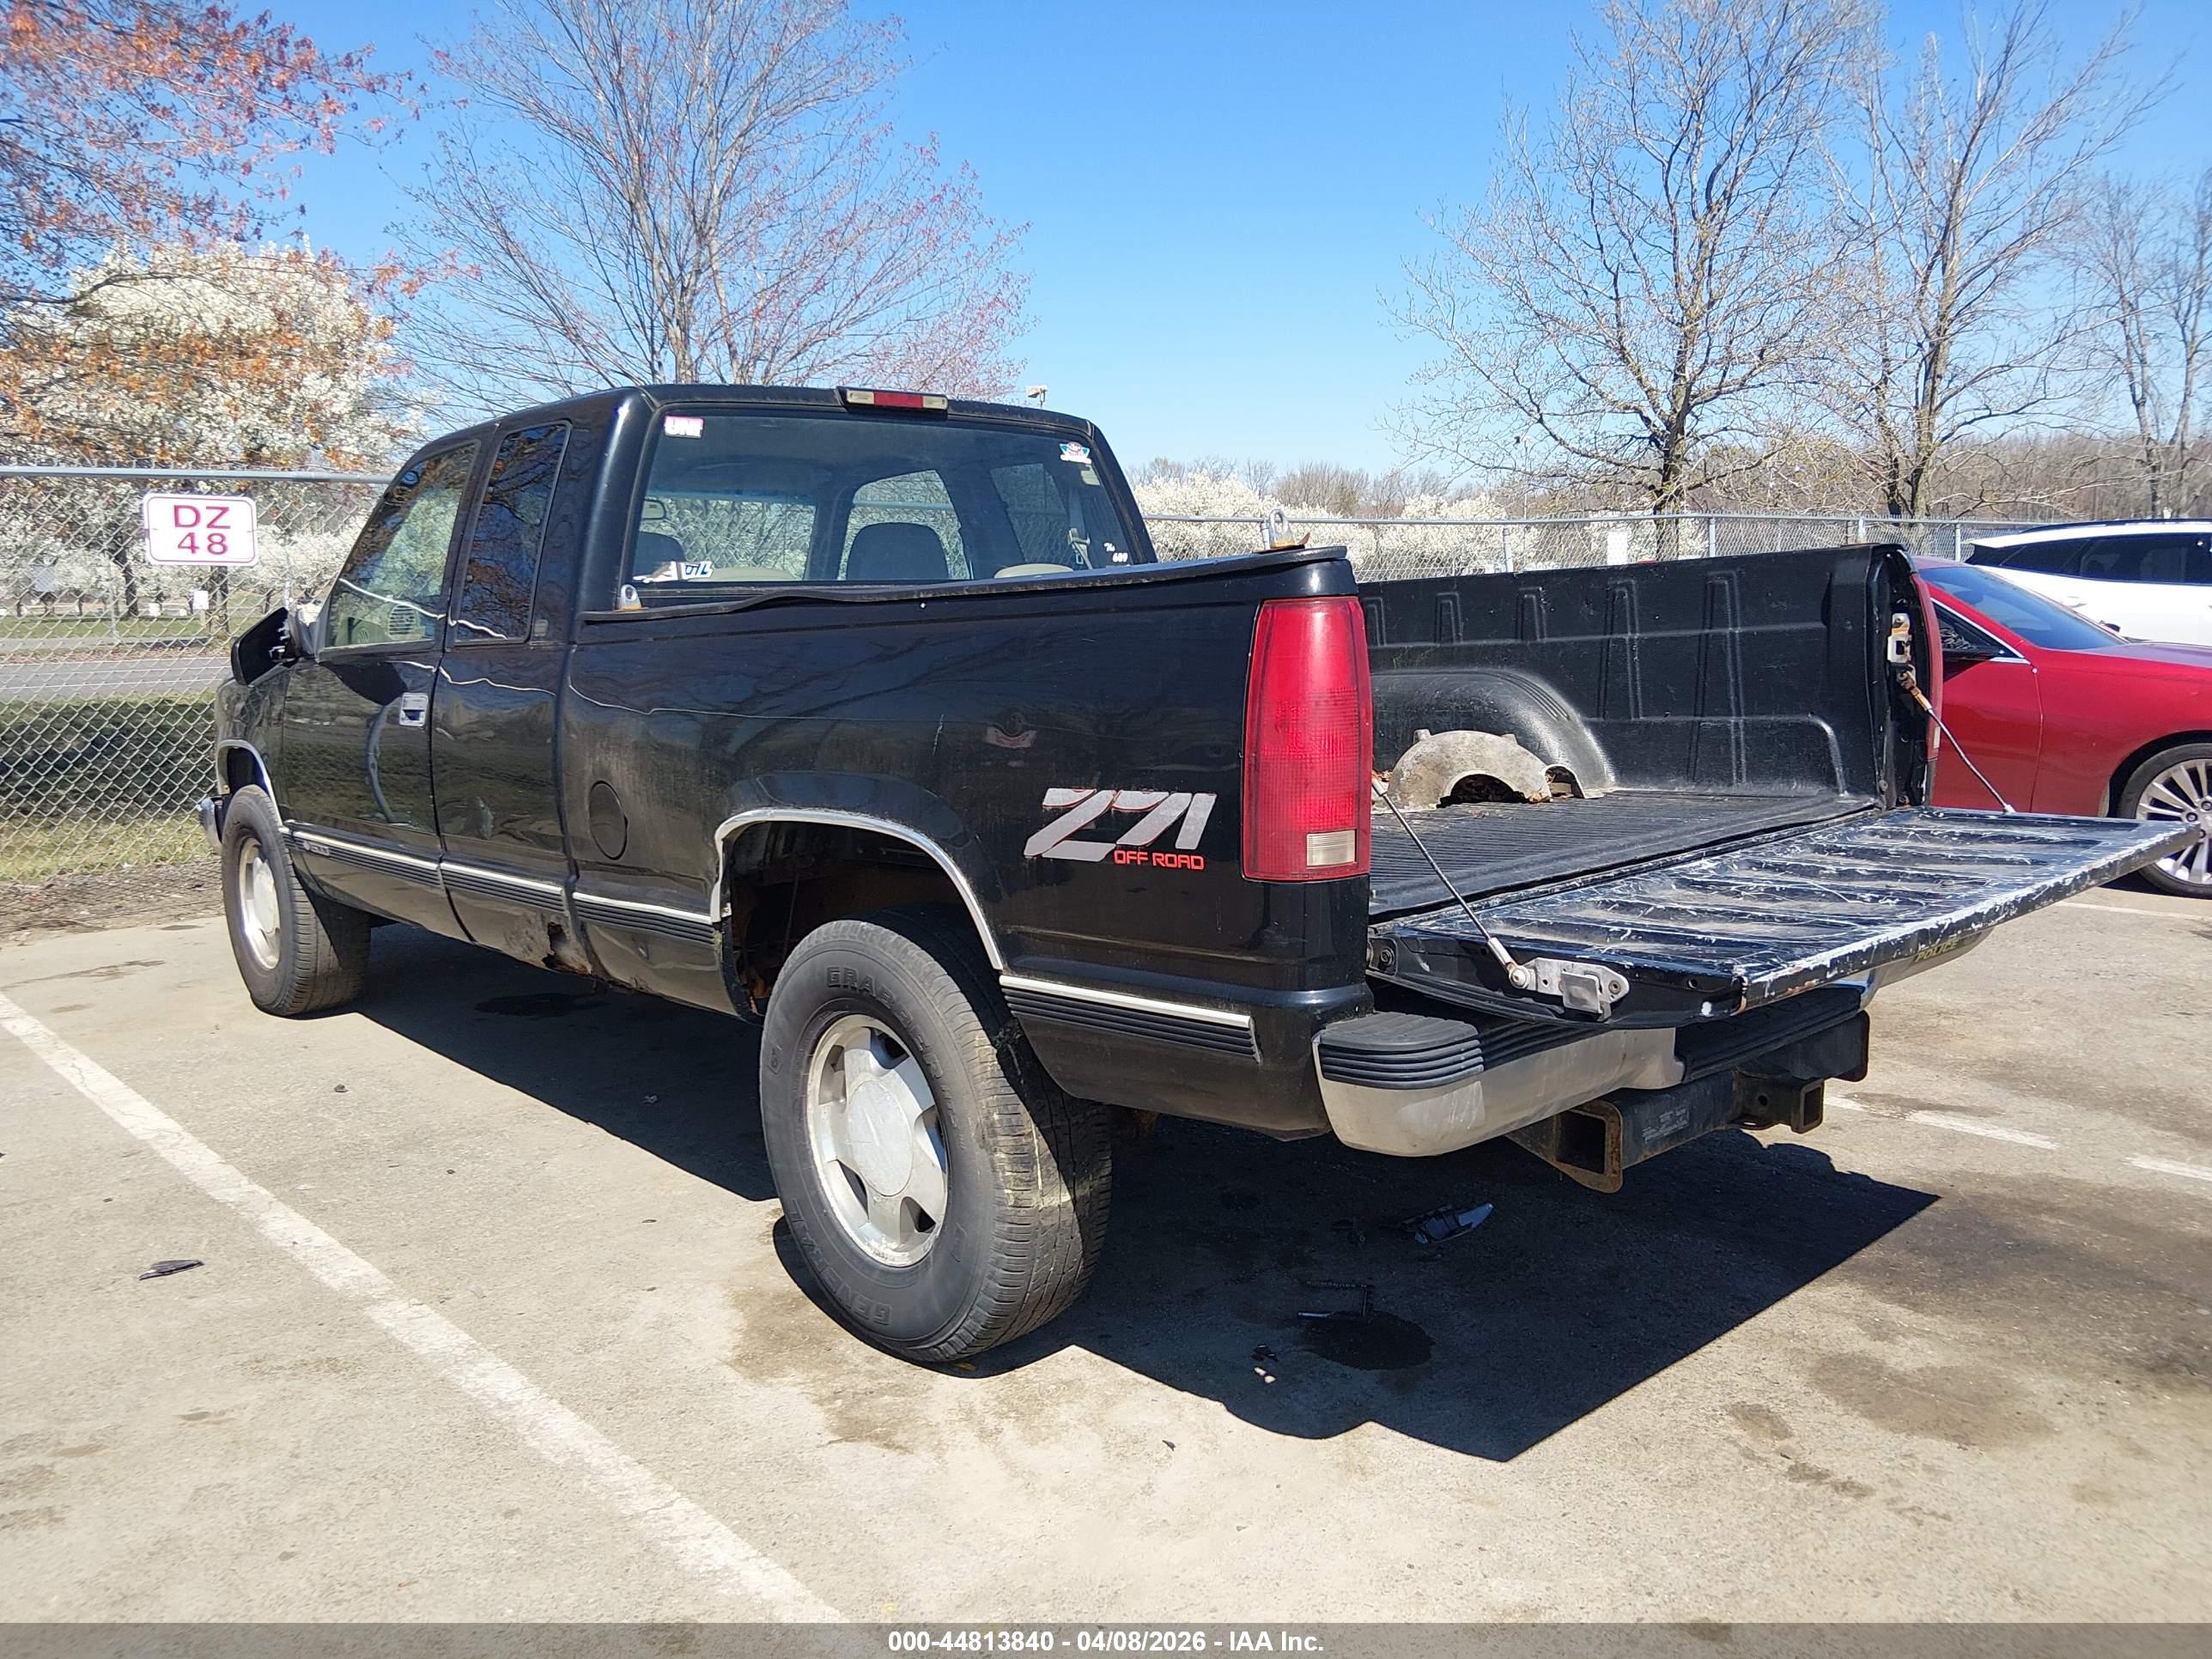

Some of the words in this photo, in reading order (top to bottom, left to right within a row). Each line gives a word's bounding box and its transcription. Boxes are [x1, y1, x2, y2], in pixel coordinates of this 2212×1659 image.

[173, 505, 231, 529] DZ
[177, 532, 229, 556] 48
[1024, 787, 1218, 862] Z71
[1114, 850, 1149, 866] OFF
[1152, 852, 1206, 871] ROAD
[825, 965, 945, 1079] GRABBER
[789, 1197, 893, 1327] GENERAL
